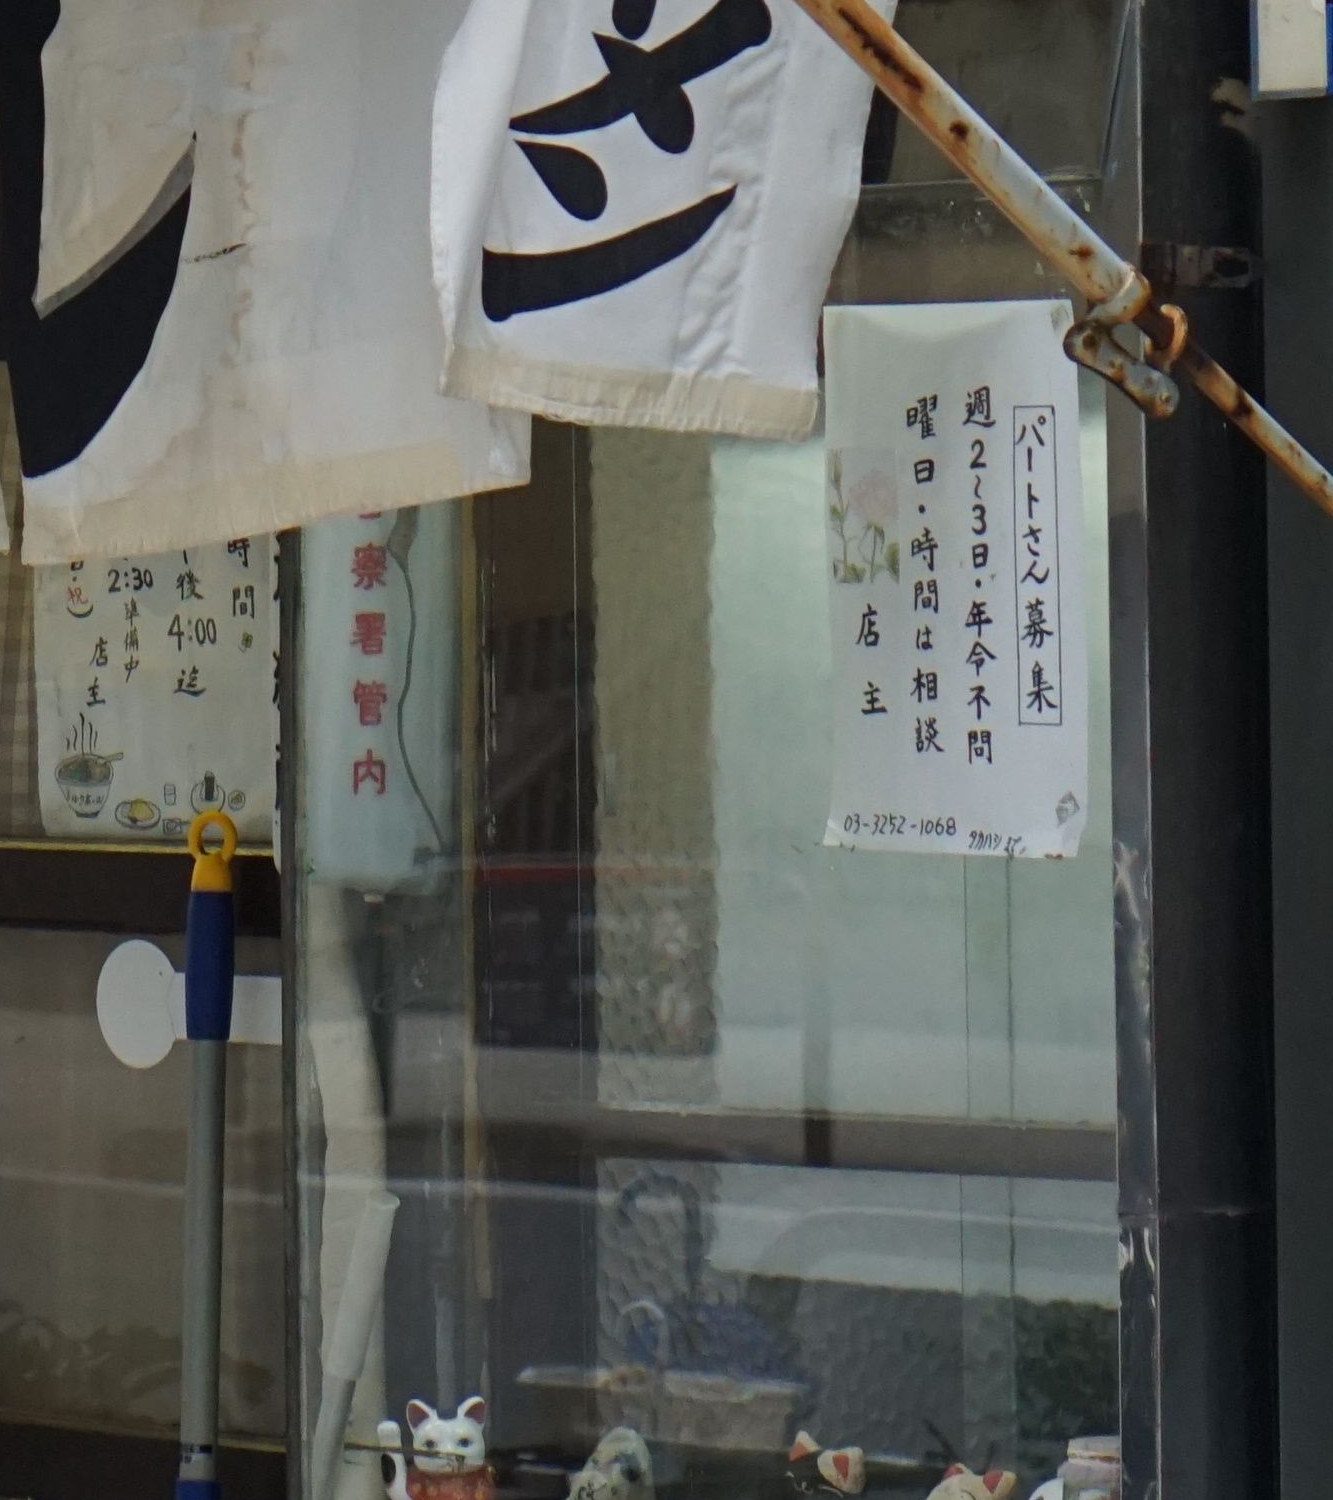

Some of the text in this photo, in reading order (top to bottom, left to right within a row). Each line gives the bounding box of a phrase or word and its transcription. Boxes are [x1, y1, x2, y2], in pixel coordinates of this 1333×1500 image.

[350, 511, 388, 797] 察署管内
[855, 603, 888, 715] 店主
[906, 394, 945, 753] 曜日・時間は相談
[1015, 415, 1058, 713] パートさん募集
[843, 812, 957, 837] 03-3252-1068
